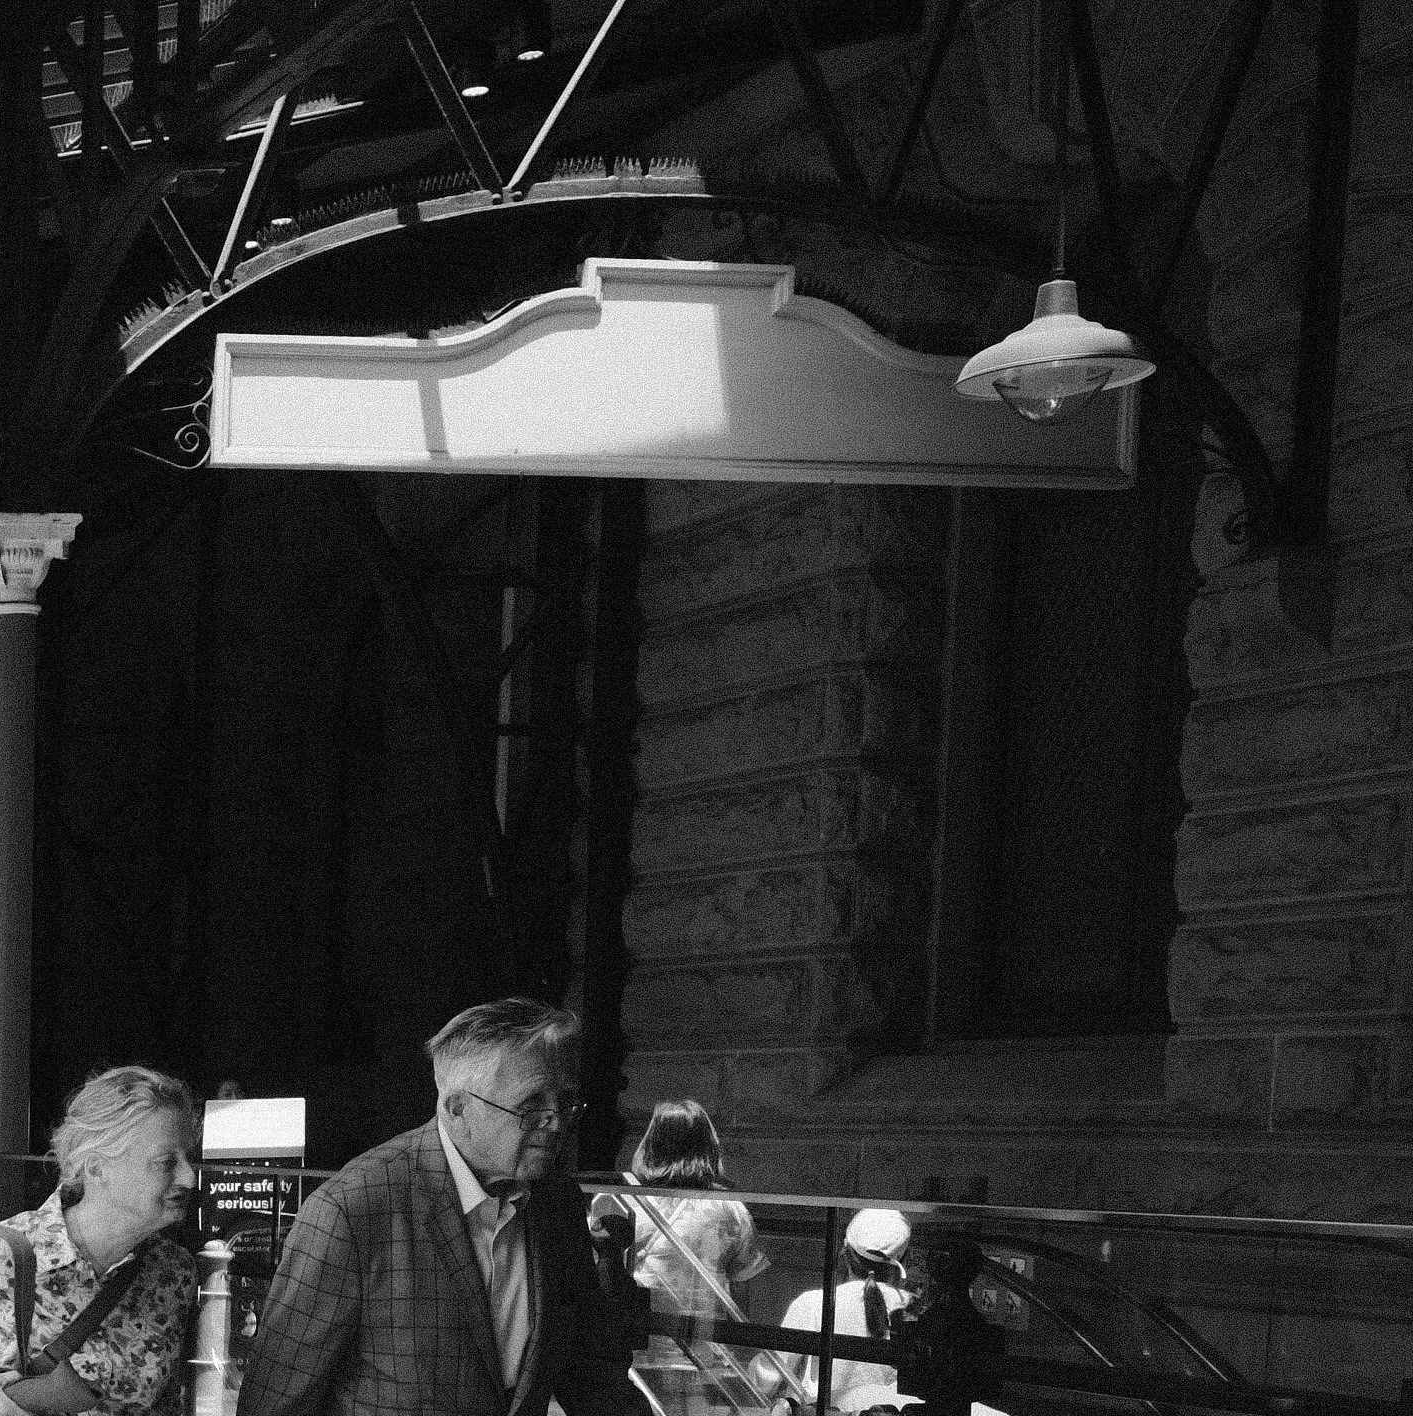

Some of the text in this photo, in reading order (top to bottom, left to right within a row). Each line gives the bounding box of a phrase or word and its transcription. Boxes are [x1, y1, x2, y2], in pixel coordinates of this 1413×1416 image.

[209, 1178, 293, 1195] your safety
[217, 1196, 286, 1211] seriously
